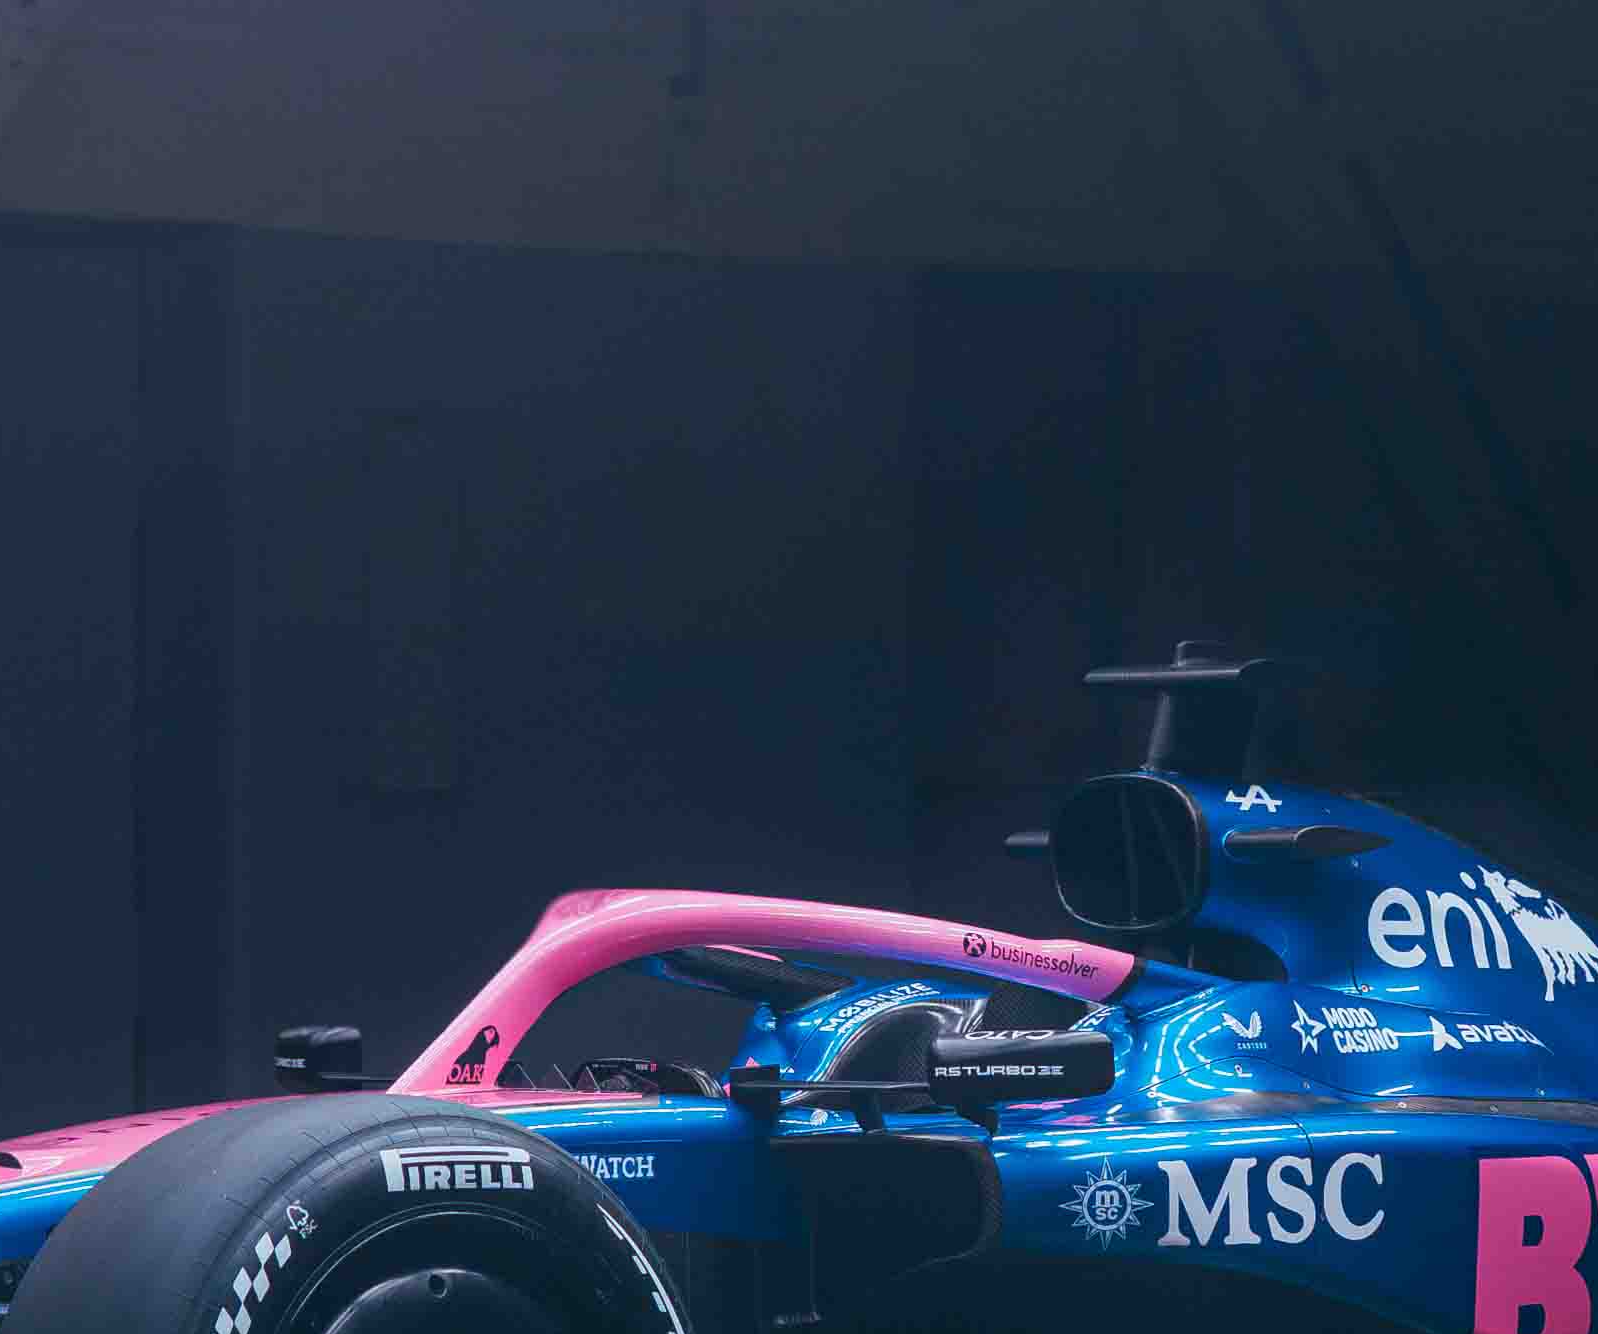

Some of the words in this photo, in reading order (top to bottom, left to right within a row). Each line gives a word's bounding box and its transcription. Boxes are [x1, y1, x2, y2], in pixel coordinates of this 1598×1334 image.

[1367, 871, 1513, 969] eni
[991, 939, 1099, 979] businessolver
[1321, 1007, 1378, 1028] MODO
[1333, 1028, 1399, 1054] CASINO
[379, 1144, 535, 1193] PIRELLI
[1157, 1152, 1385, 1247] MSC
